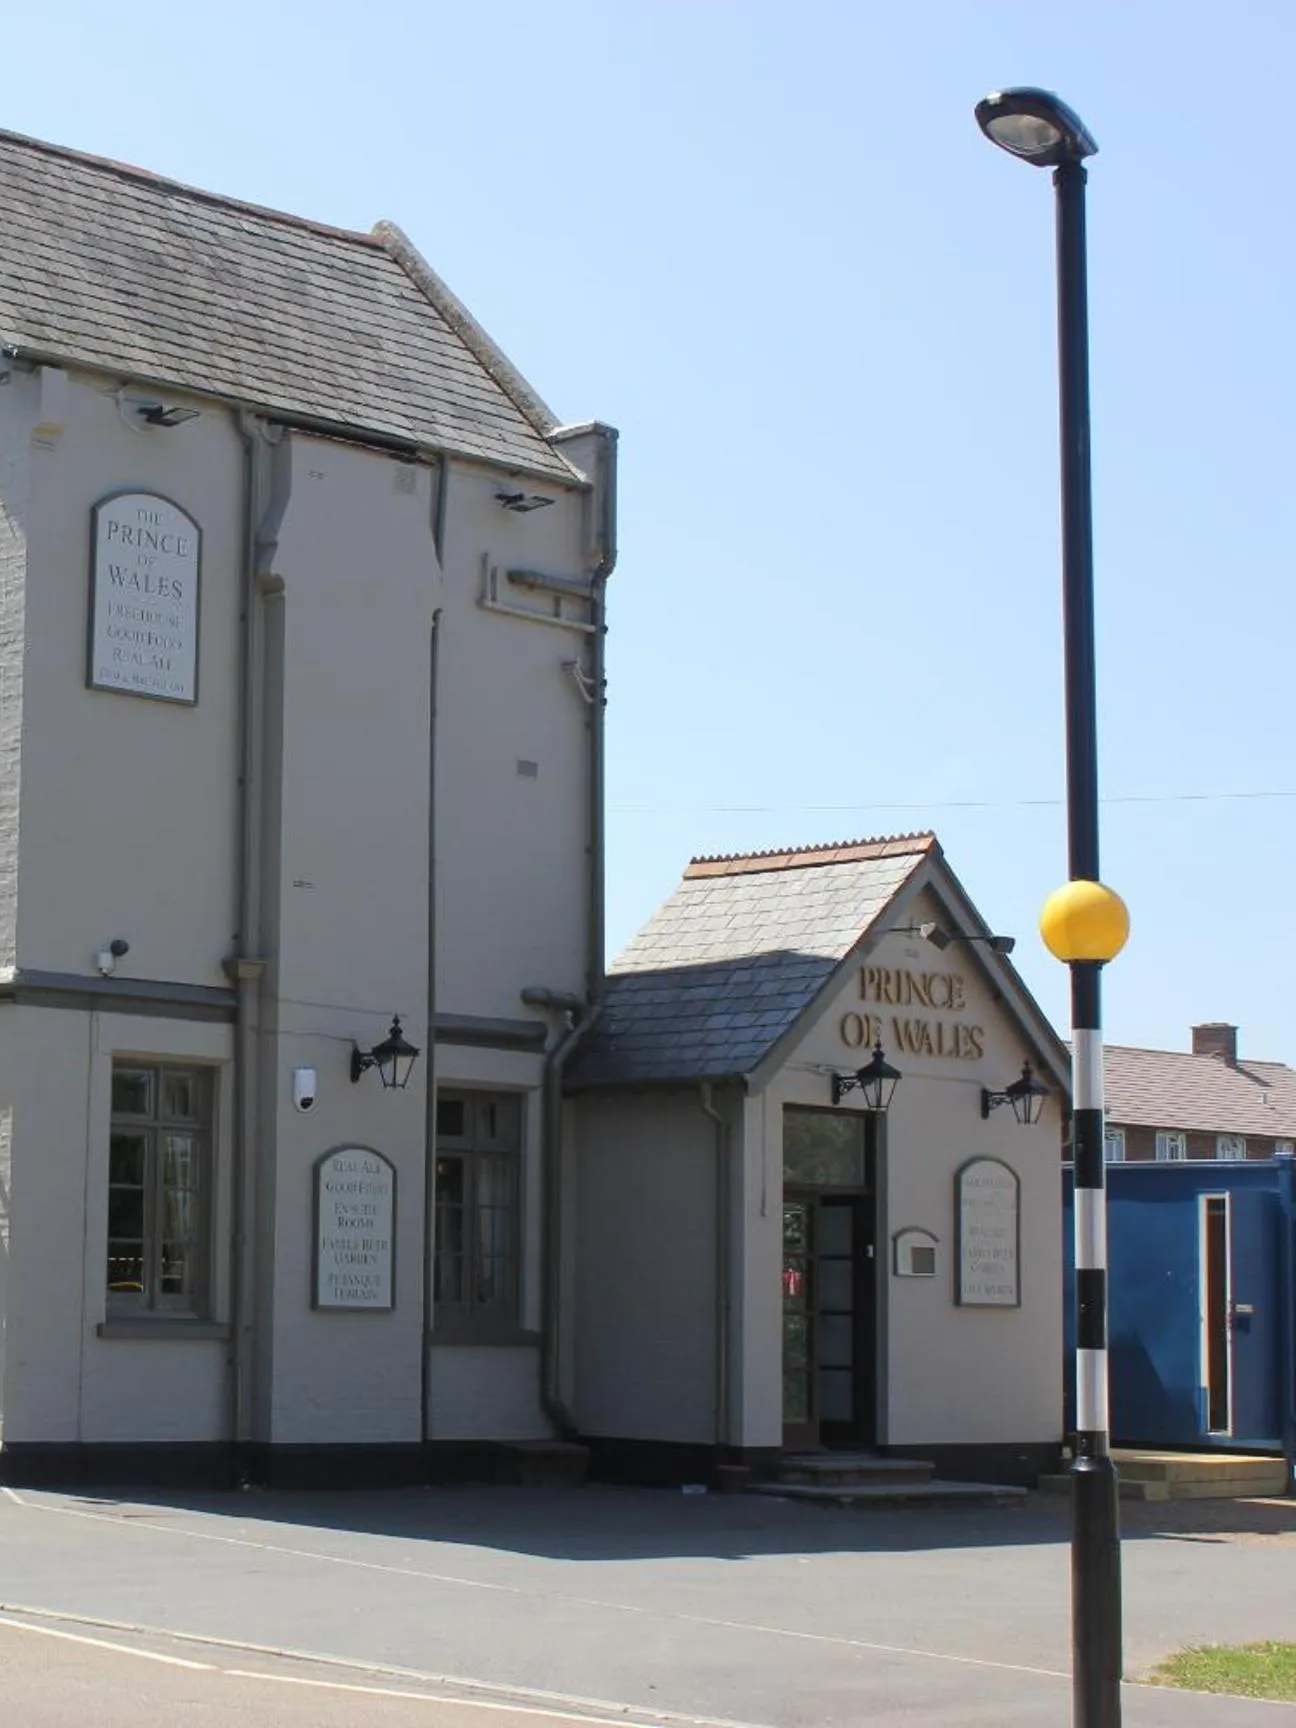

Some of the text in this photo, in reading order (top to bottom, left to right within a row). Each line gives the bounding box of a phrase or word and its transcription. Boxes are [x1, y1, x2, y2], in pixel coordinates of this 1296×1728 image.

[107, 520, 189, 557] PRINCE
[108, 564, 183, 600] WALES
[859, 965, 966, 1011] PRINCE
[840, 1011, 986, 1060] OF WALES
